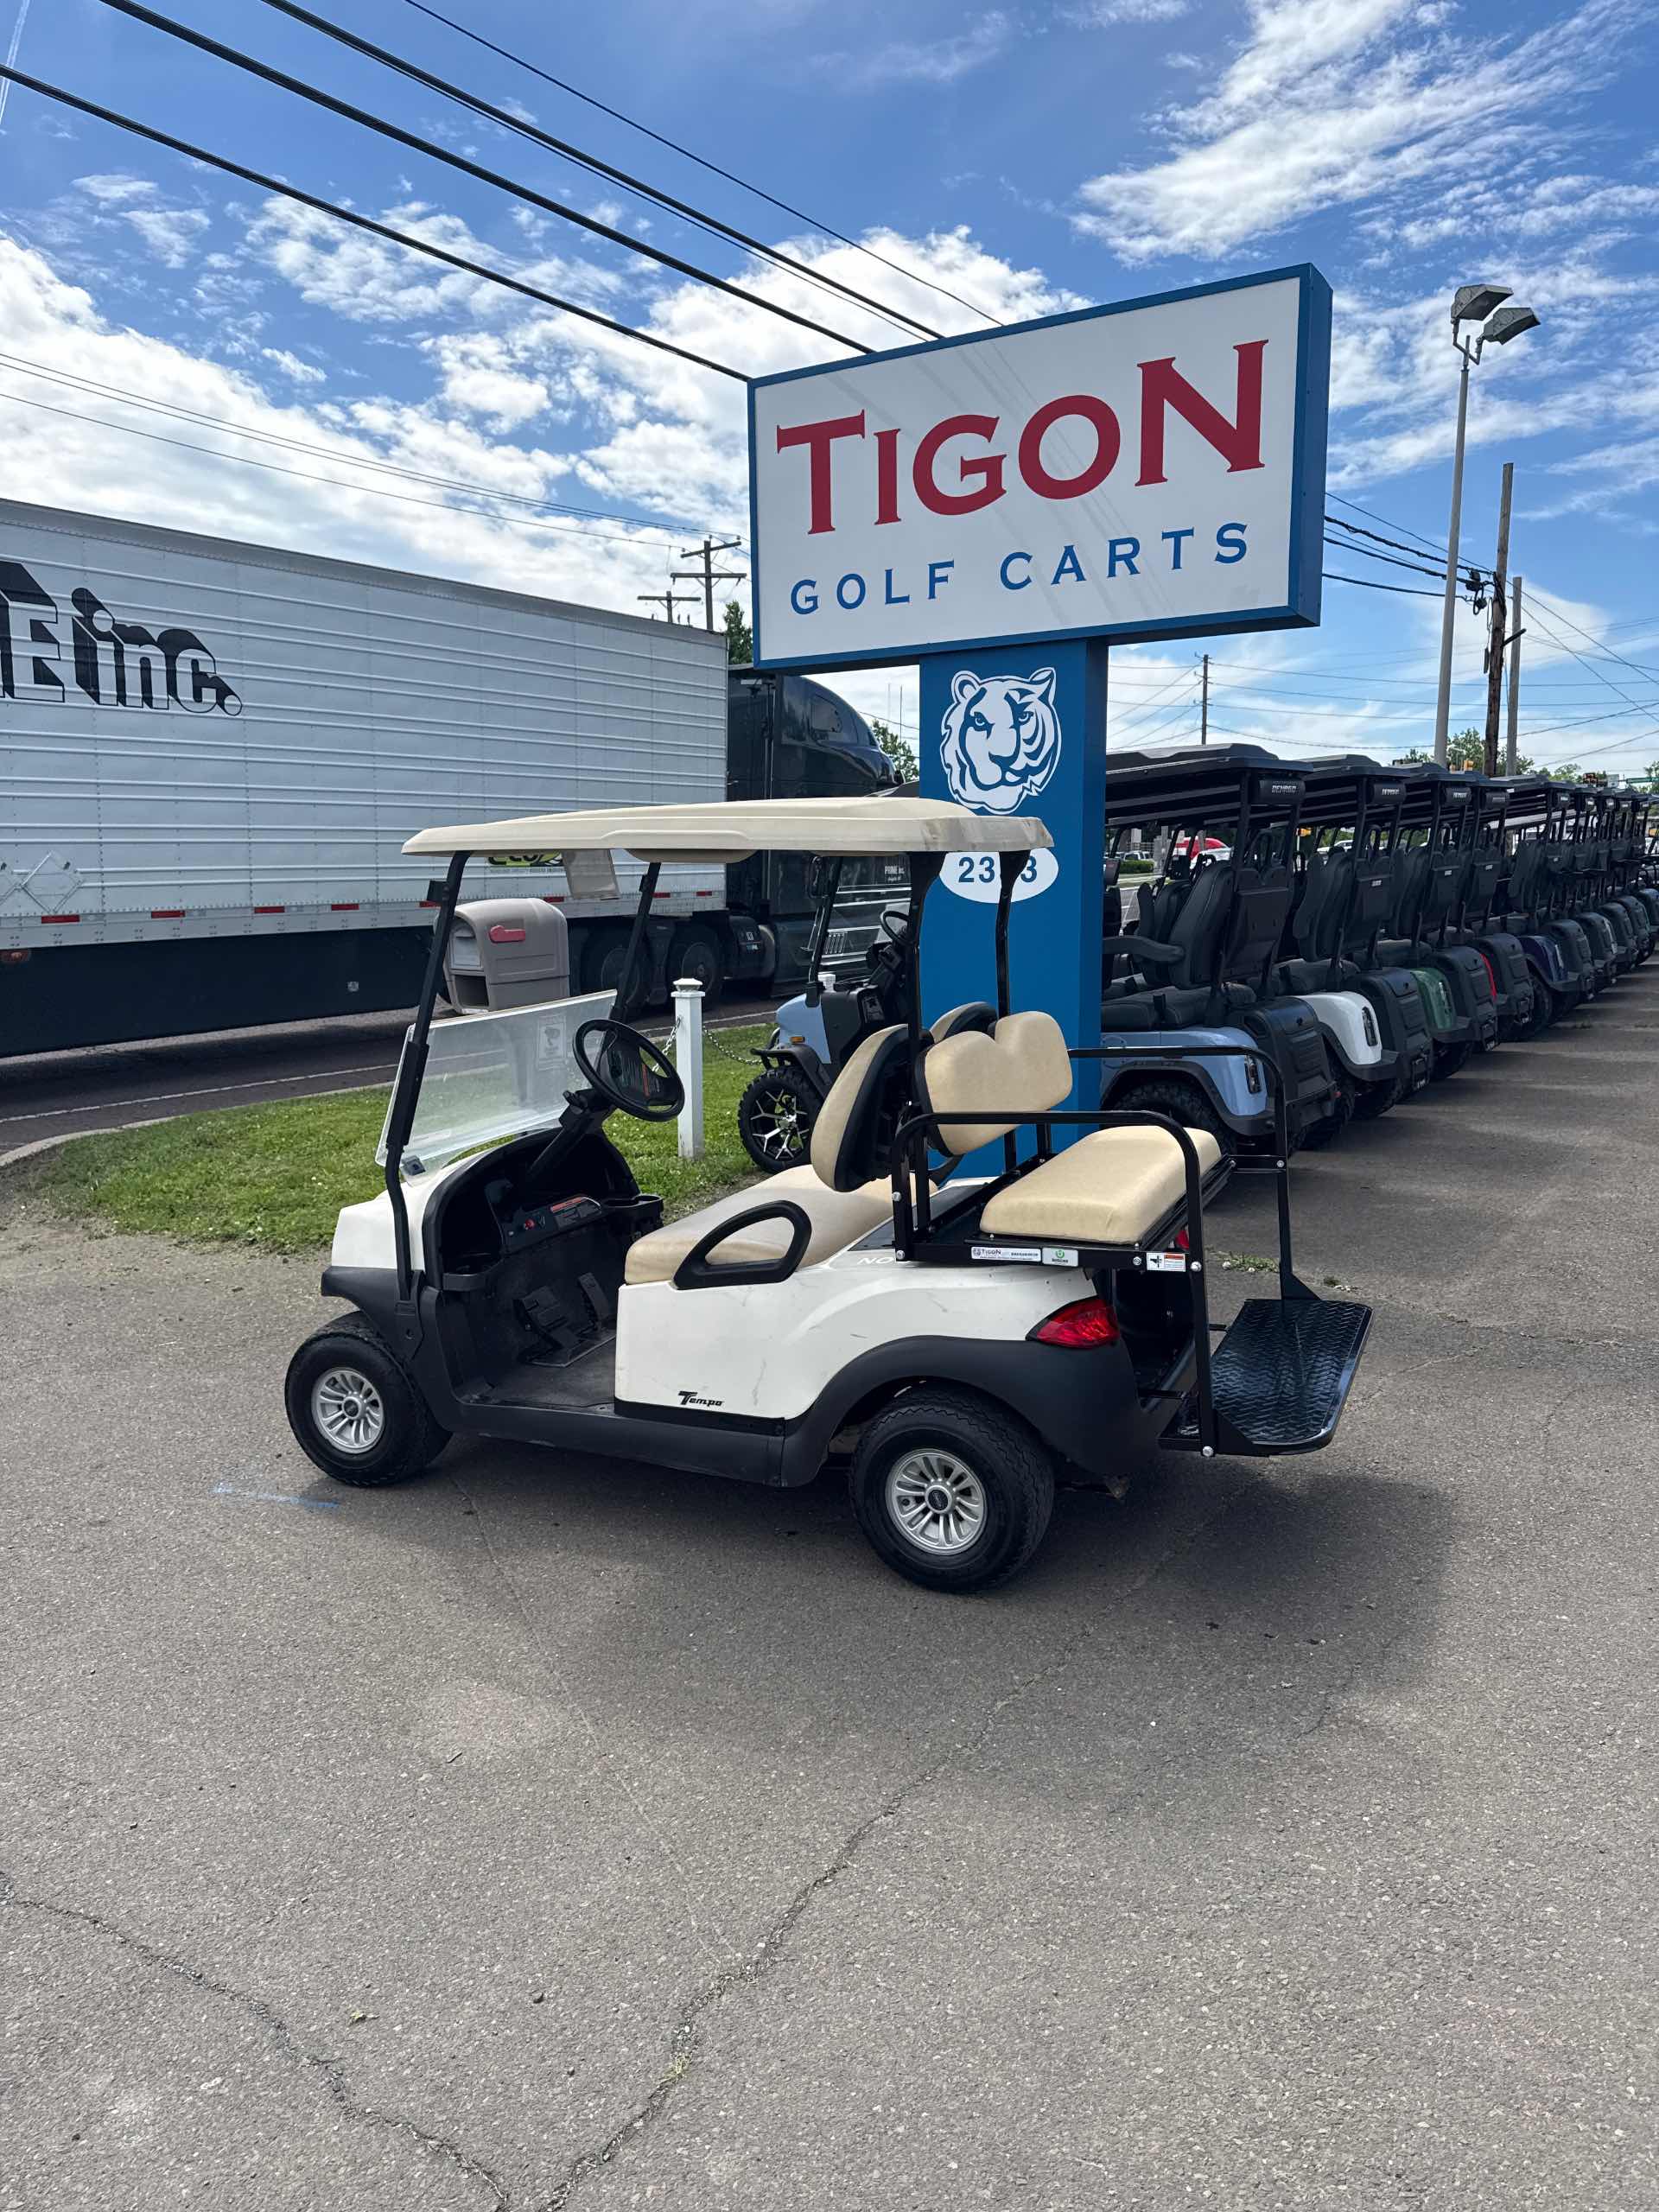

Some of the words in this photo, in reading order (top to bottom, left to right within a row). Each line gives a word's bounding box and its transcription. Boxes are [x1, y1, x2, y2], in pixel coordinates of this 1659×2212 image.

[777, 340, 1269, 535] TIGON
[791, 560, 955, 615] GOLF
[1000, 523, 1248, 589] CARTS
[0, 562, 65, 702] E
[72, 588, 243, 716] inc.
[958, 856, 1038, 883] 233
[677, 1390, 725, 1408] Tempo
